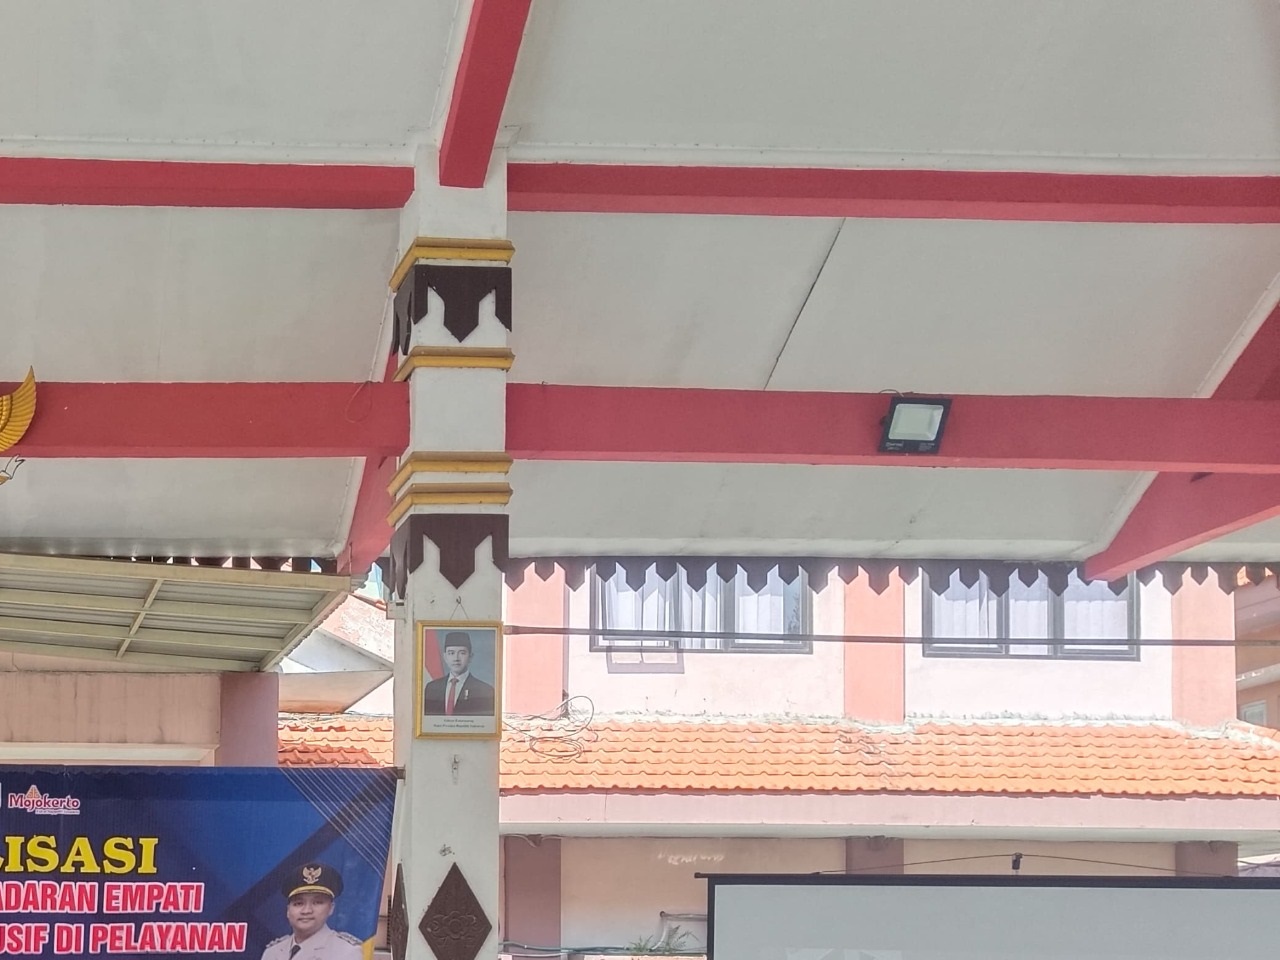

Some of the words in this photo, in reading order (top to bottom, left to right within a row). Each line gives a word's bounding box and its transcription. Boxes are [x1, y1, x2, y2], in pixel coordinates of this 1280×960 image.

[9, 793, 80, 811] Mojokerto
[104, 882, 205, 914] EMPATI
[54, 923, 84, 954] DI
[89, 922, 247, 953] PELAYANAN
